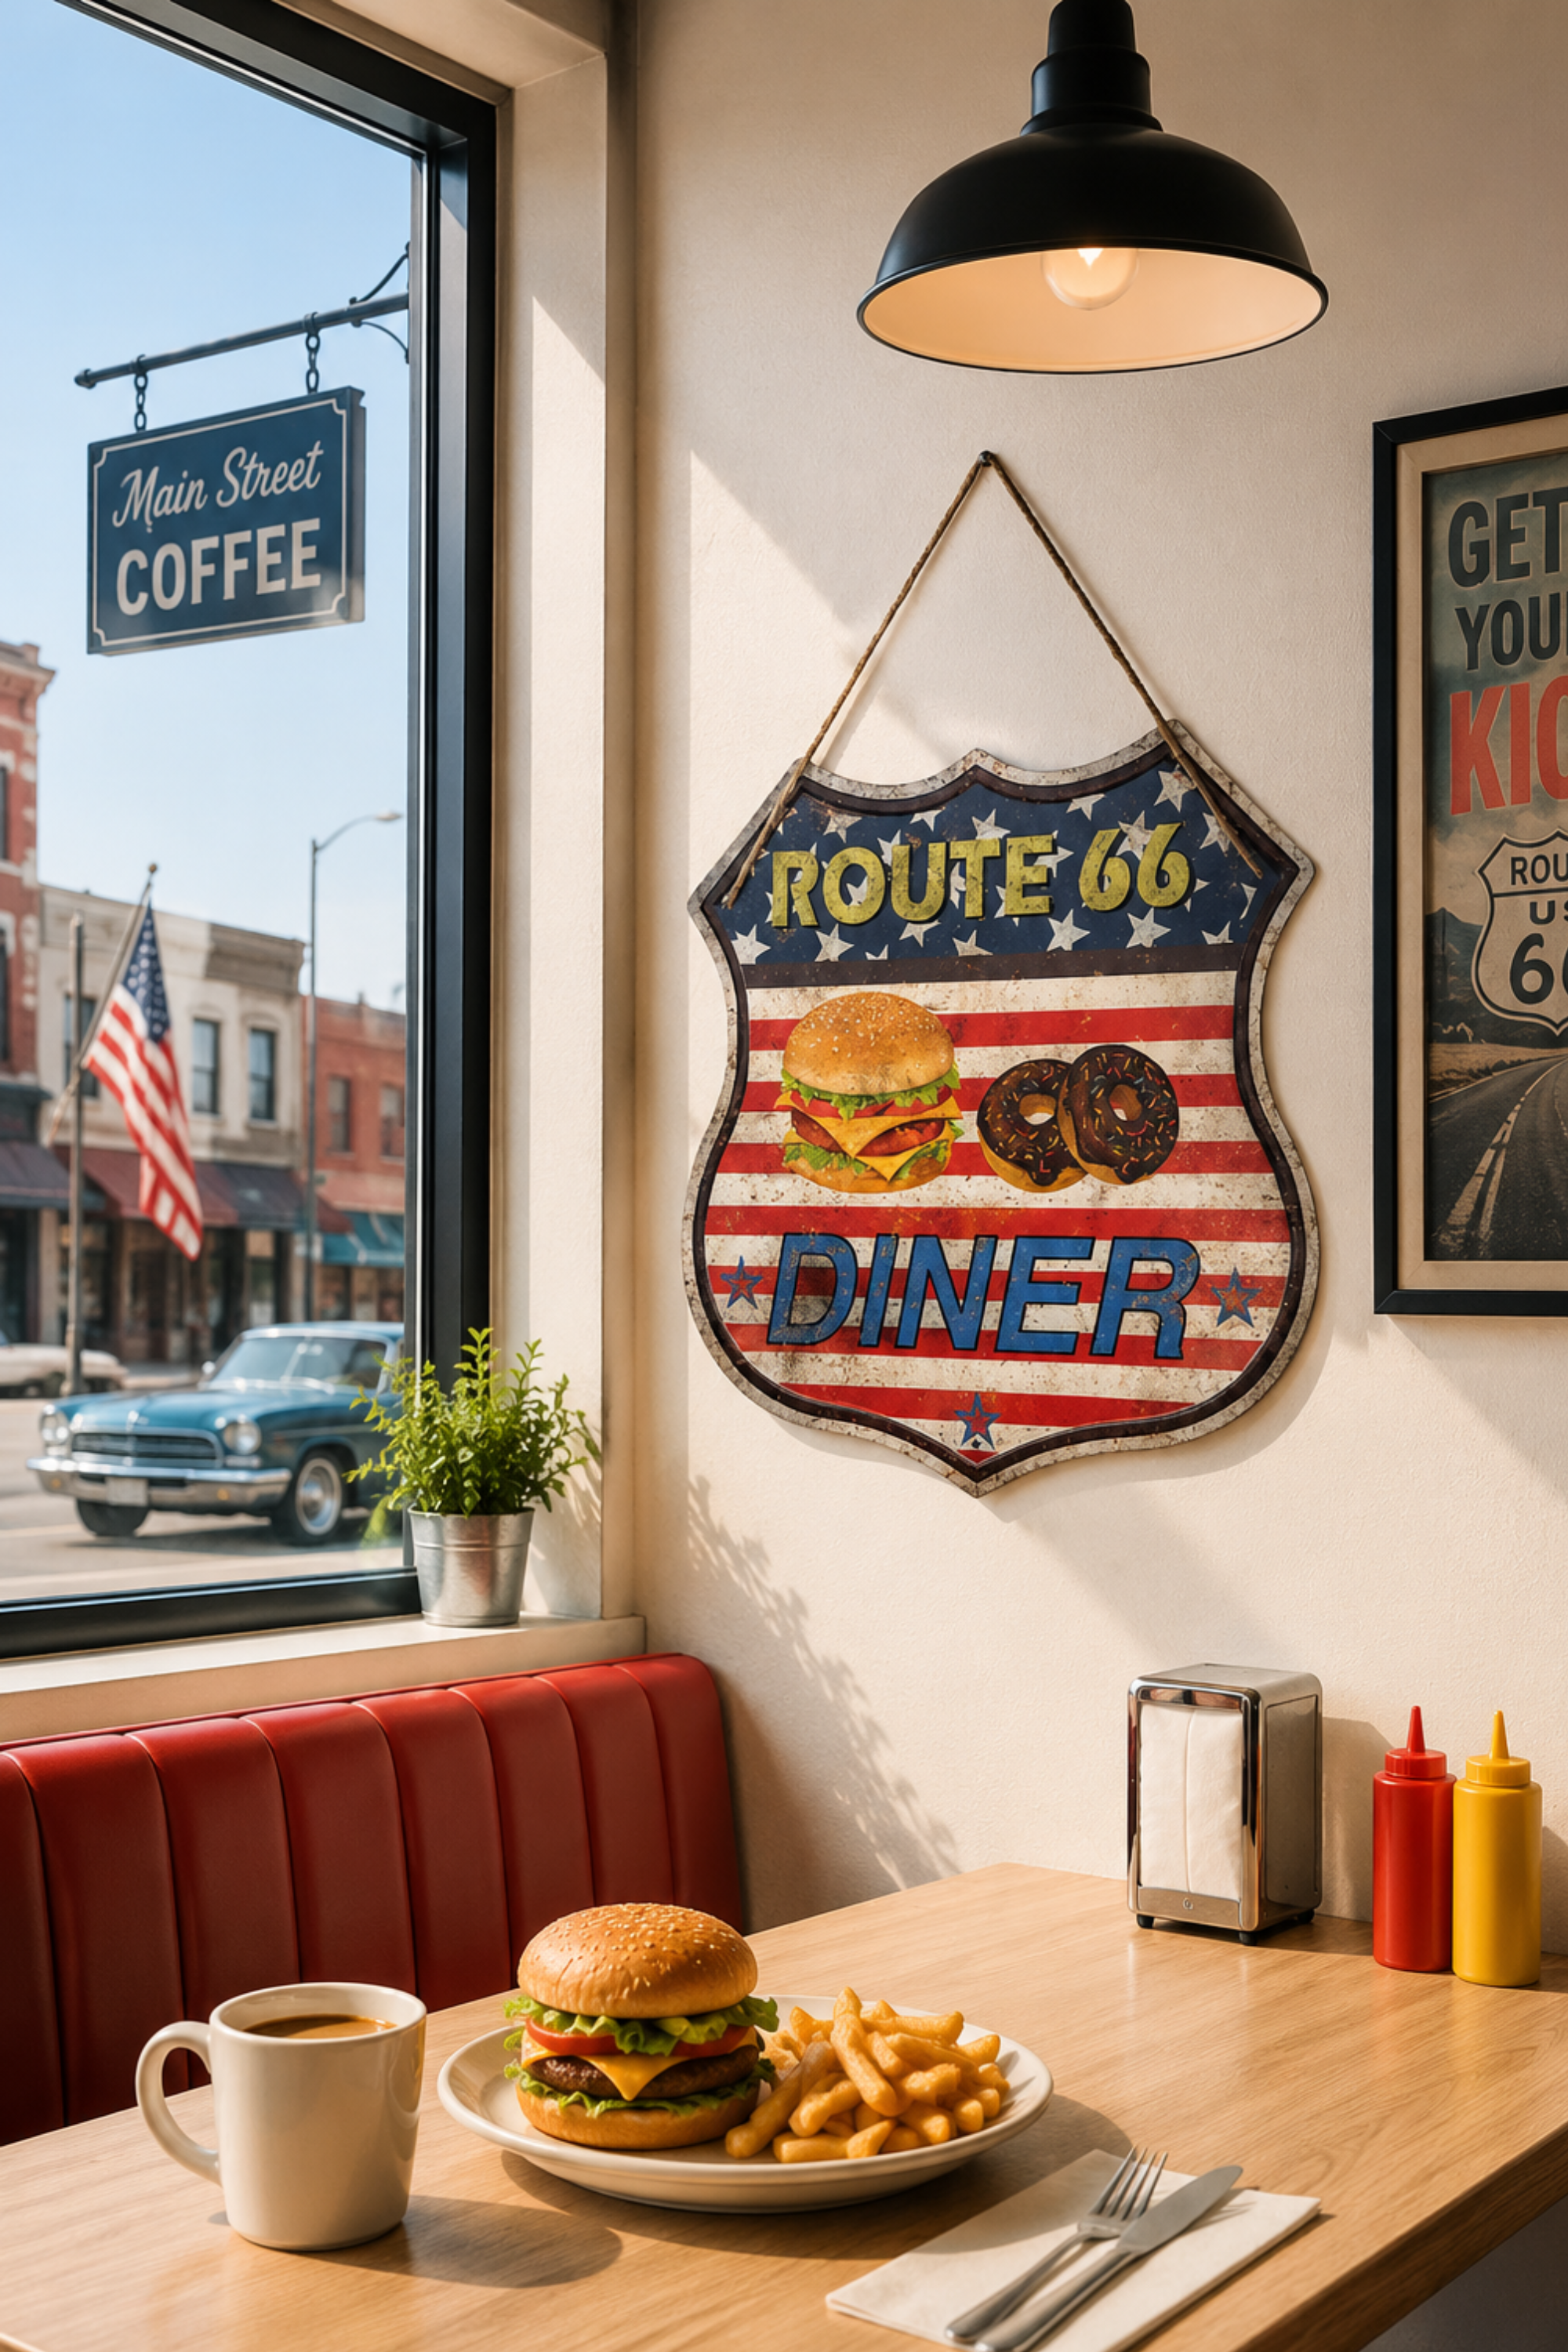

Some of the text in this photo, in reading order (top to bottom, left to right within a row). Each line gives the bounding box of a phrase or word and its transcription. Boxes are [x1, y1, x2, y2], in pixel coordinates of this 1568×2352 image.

[112, 441, 324, 533] Main Street
[117, 517, 321, 616] COFFEE
[1448, 486, 1568, 587] GET
[1454, 591, 1568, 670] YOU
[771, 822, 1191, 927] ROUTE 66
[1530, 900, 1568, 925] U
[1510, 933, 1568, 1004] 6
[766, 1232, 1201, 1359] DINER
